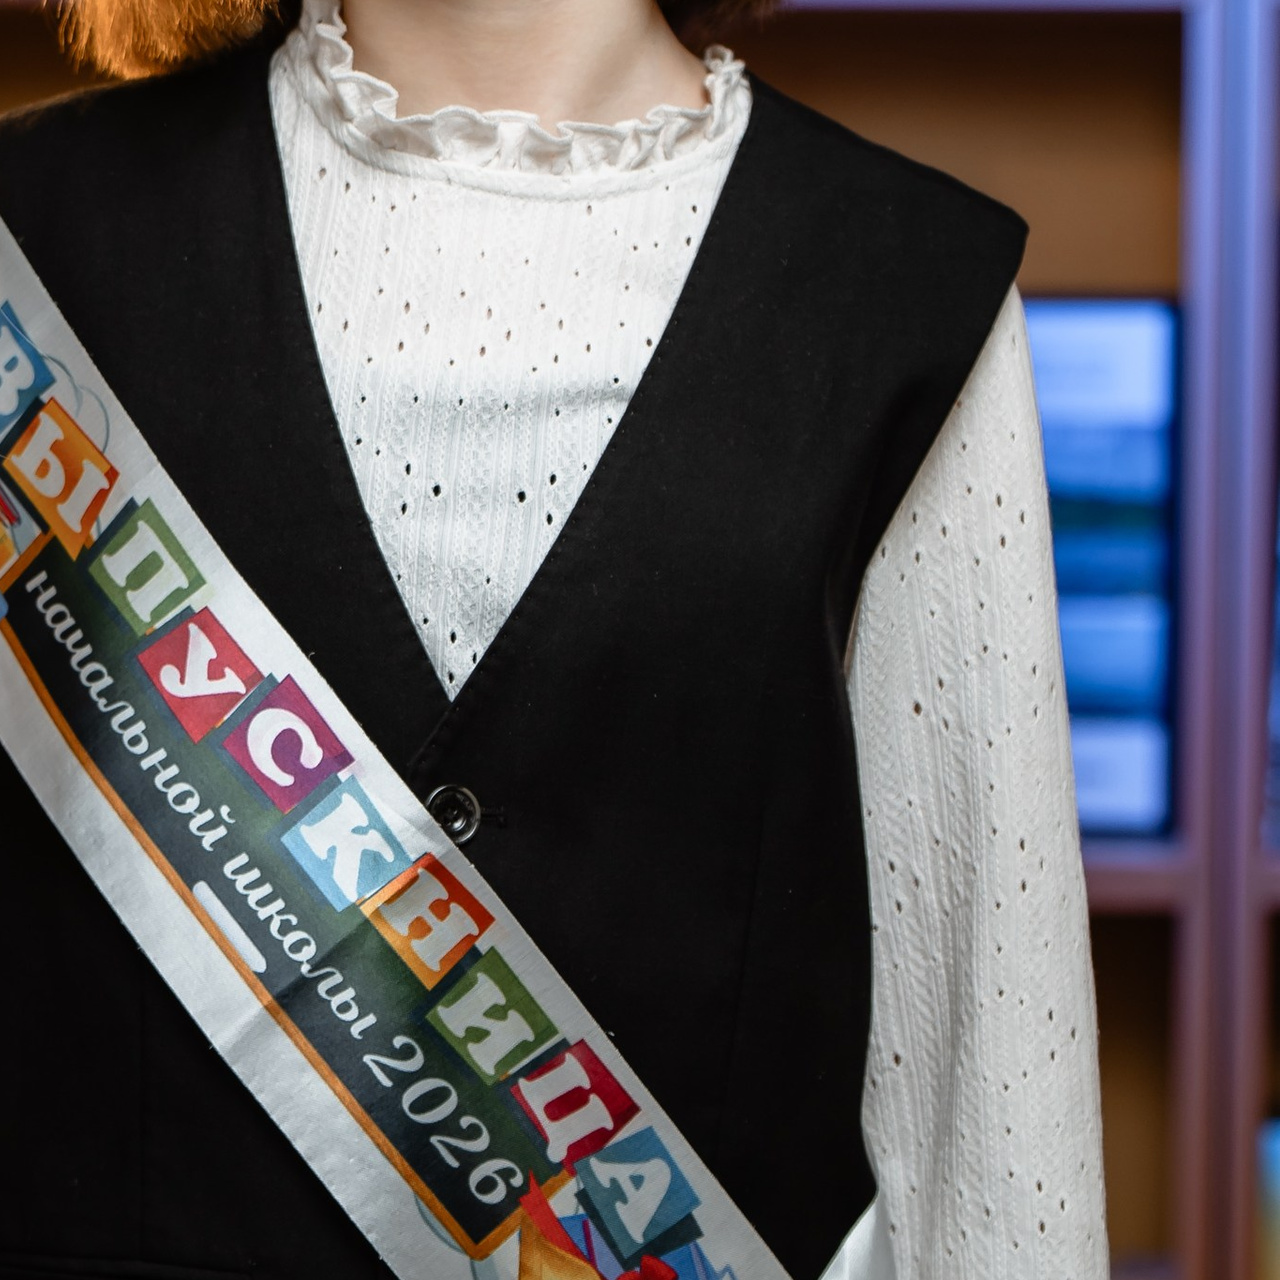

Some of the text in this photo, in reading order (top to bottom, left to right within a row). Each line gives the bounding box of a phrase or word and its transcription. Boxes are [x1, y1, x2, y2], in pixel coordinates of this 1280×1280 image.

[24, 570, 525, 1206] начальной школы 2026
